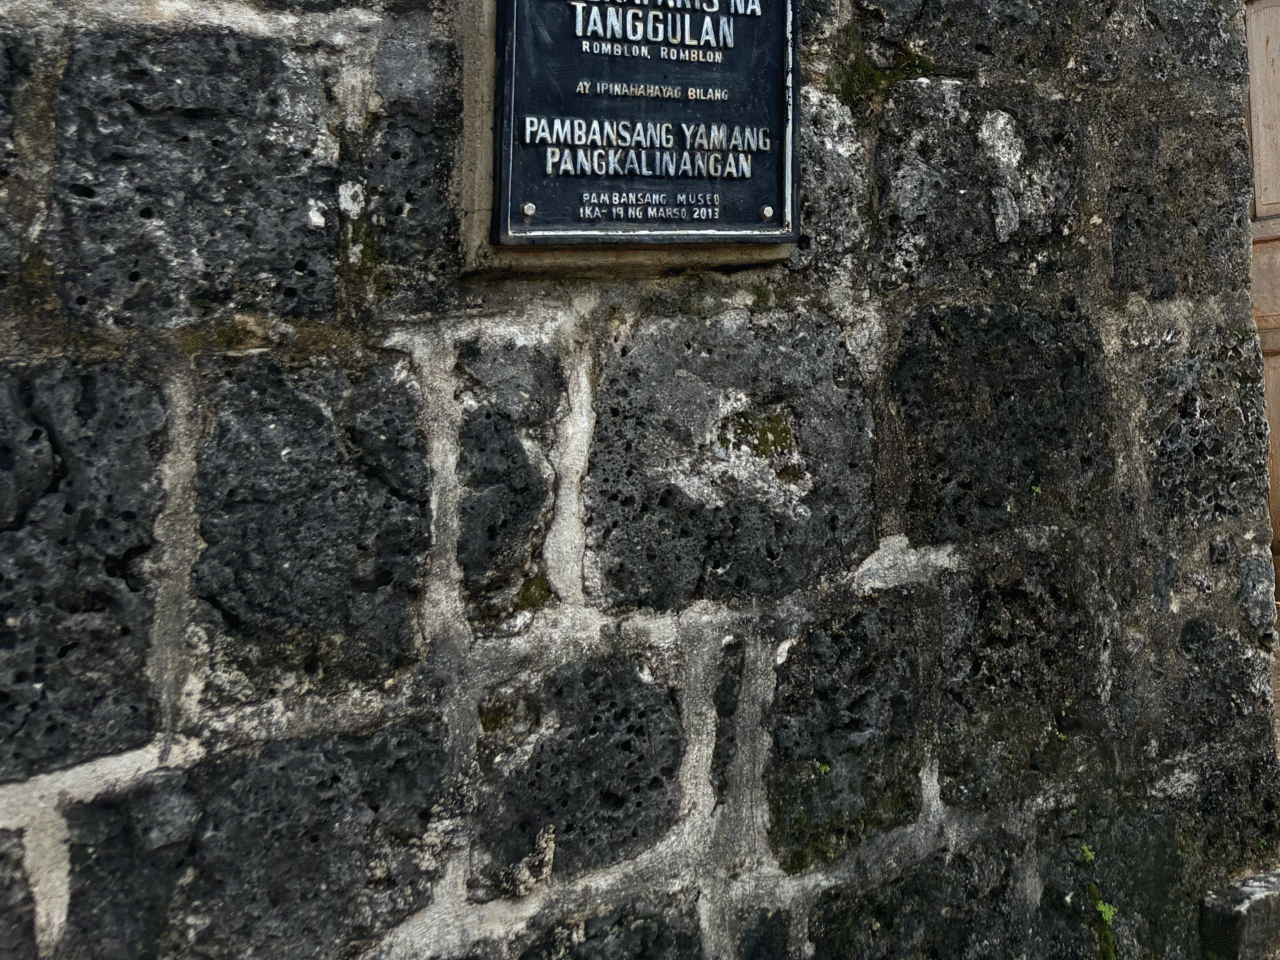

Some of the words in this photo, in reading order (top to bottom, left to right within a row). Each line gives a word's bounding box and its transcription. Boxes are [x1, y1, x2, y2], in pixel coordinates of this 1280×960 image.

[571, 1, 734, 48] TANGGULAN
[660, 46, 723, 64] ROMBLON
[576, 81, 591, 94] AY
[596, 82, 682, 99] IPINAHAHAYAG
[688, 87, 729, 101] BILANG
[525, 117, 674, 149] PAMBANSANG
[681, 123, 771, 152] YAMANG
[546, 147, 752, 179] PANGKALINANGAN
[582, 192, 667, 205] PAMBANSANG
[676, 193, 720, 206] MUSEO
[628, 207, 643, 219] NG
[692, 207, 720, 220] 2013
